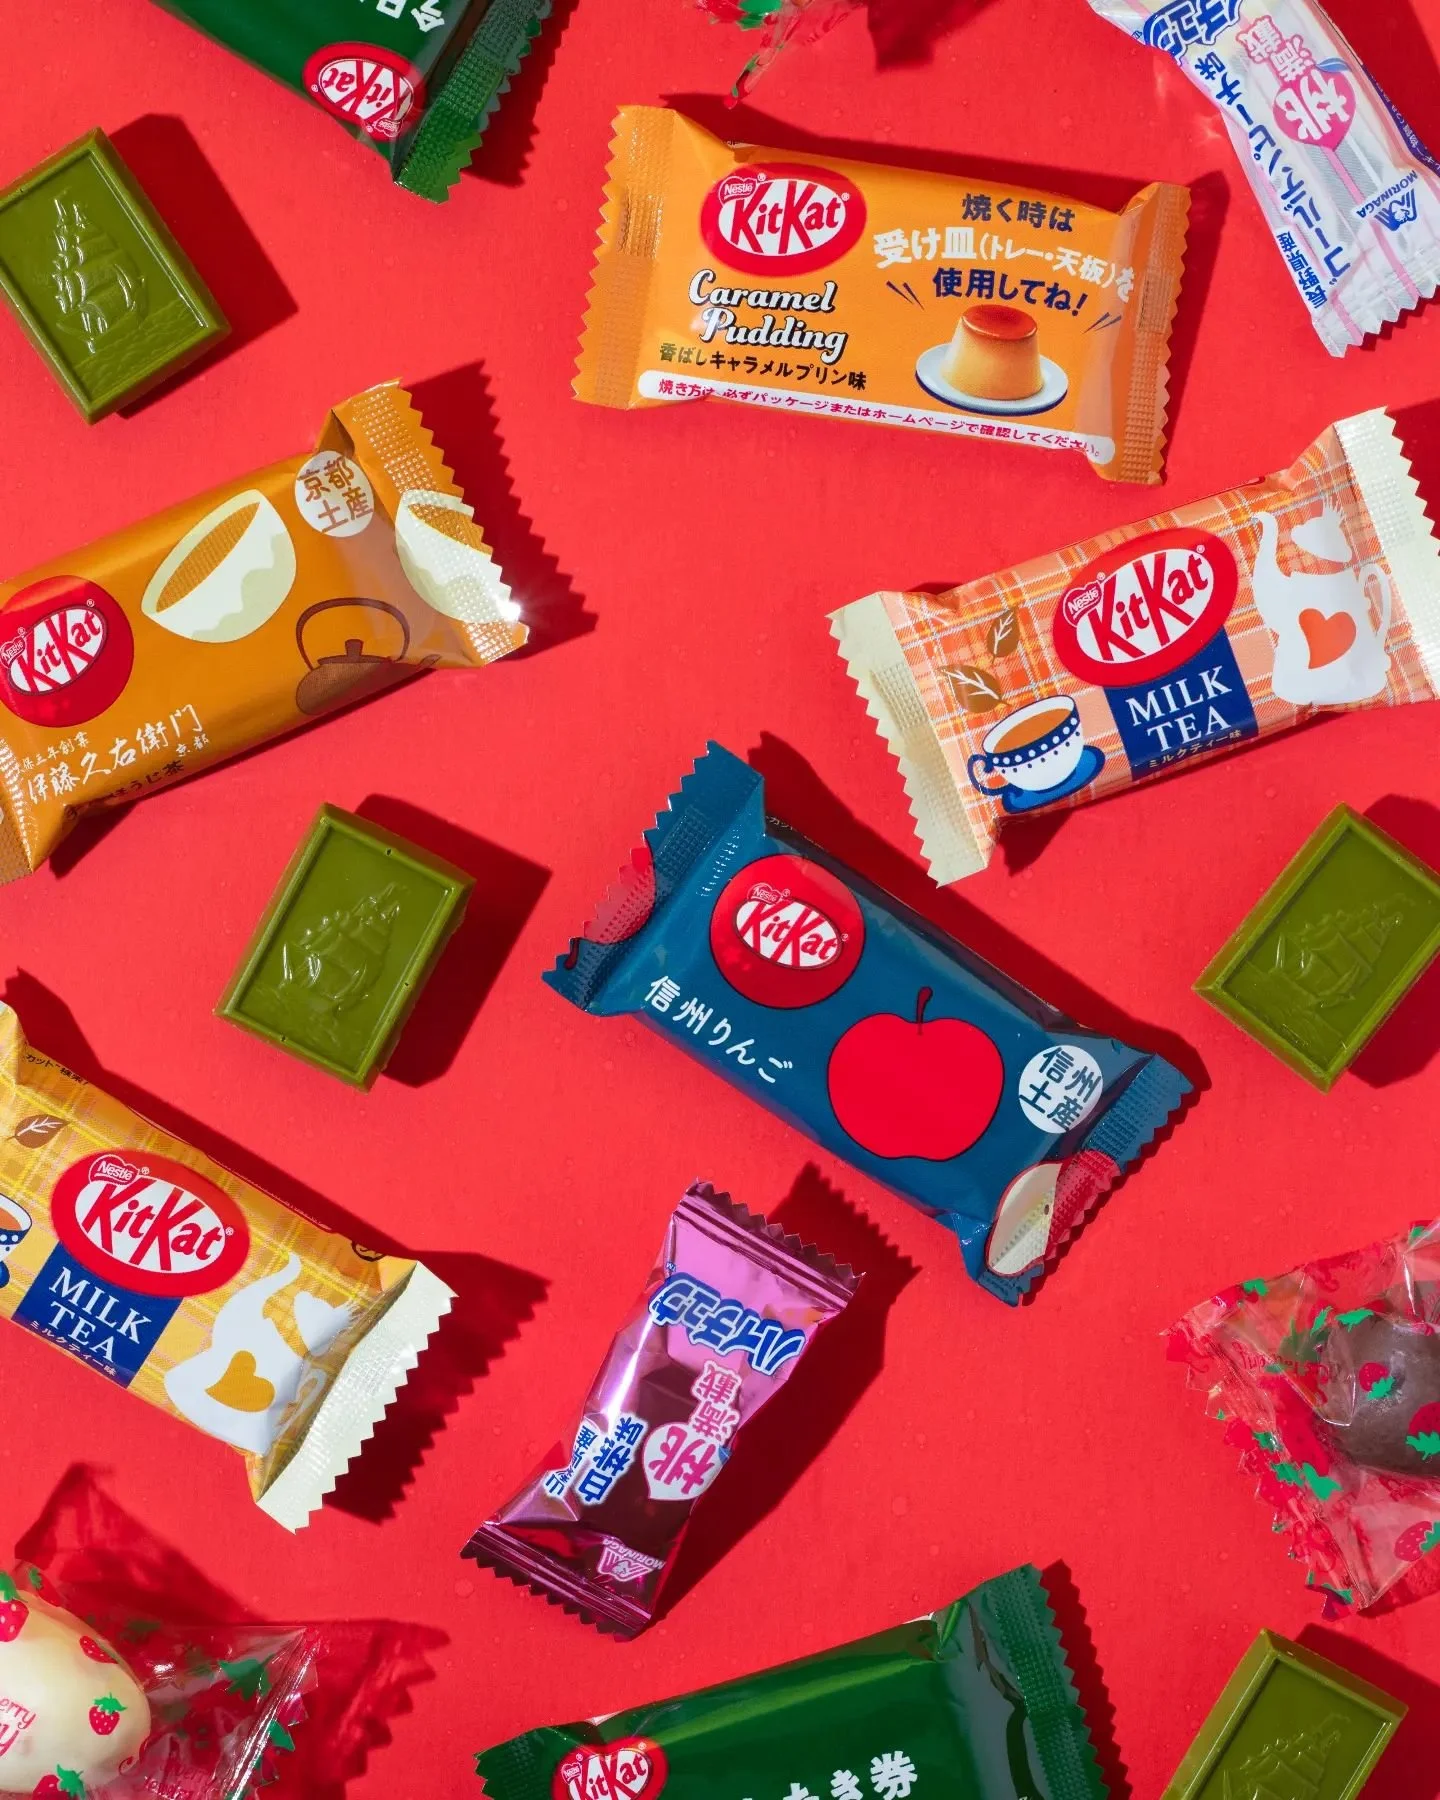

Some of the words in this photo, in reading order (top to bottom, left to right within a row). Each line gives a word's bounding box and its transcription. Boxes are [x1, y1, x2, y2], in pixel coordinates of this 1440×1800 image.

[359, 0, 445, 32] 今日
[322, 60, 412, 121] KitKat
[1195, 52, 1350, 285] ゴールデンピーチ味
[1356, 170, 1418, 219] MORINAGA
[730, 180, 842, 254] KitKat
[961, 192, 1076, 233] 焼く時は
[688, 269, 839, 313] Caramel
[933, 267, 1088, 316] 使用してね！
[1277, 231, 1328, 309] 長野県産
[699, 307, 849, 365] Pudding
[660, 342, 867, 390] 香ばしキャラメルプリン味
[298, 456, 355, 502] 京都
[317, 487, 373, 533] 土産
[1087, 552, 1209, 661] KitKat
[17, 610, 101, 692] KitKat
[1126, 665, 1232, 726] MILK
[28, 704, 203, 804] 伊藤久右衛門
[1147, 705, 1232, 752] TEA
[1149, 728, 1242, 768] ミルクティー味
[739, 900, 838, 966] KitKat
[645, 975, 793, 1083] 信州りんご
[1042, 1046, 1101, 1102] 信州
[1019, 1080, 1085, 1132] 土産
[97, 1160, 133, 1181] Nestlé
[82, 1178, 223, 1271] KitKat
[49, 1267, 152, 1344] MILK
[50, 1301, 114, 1363] TEA
[649, 1272, 805, 1375] ハイチュウ
[30, 1320, 118, 1377] ミルクティー味
[578, 1417, 644, 1502] 白桃味
[602, 1538, 666, 1570] MORINAGA
[574, 1754, 647, 1800] KitKat
